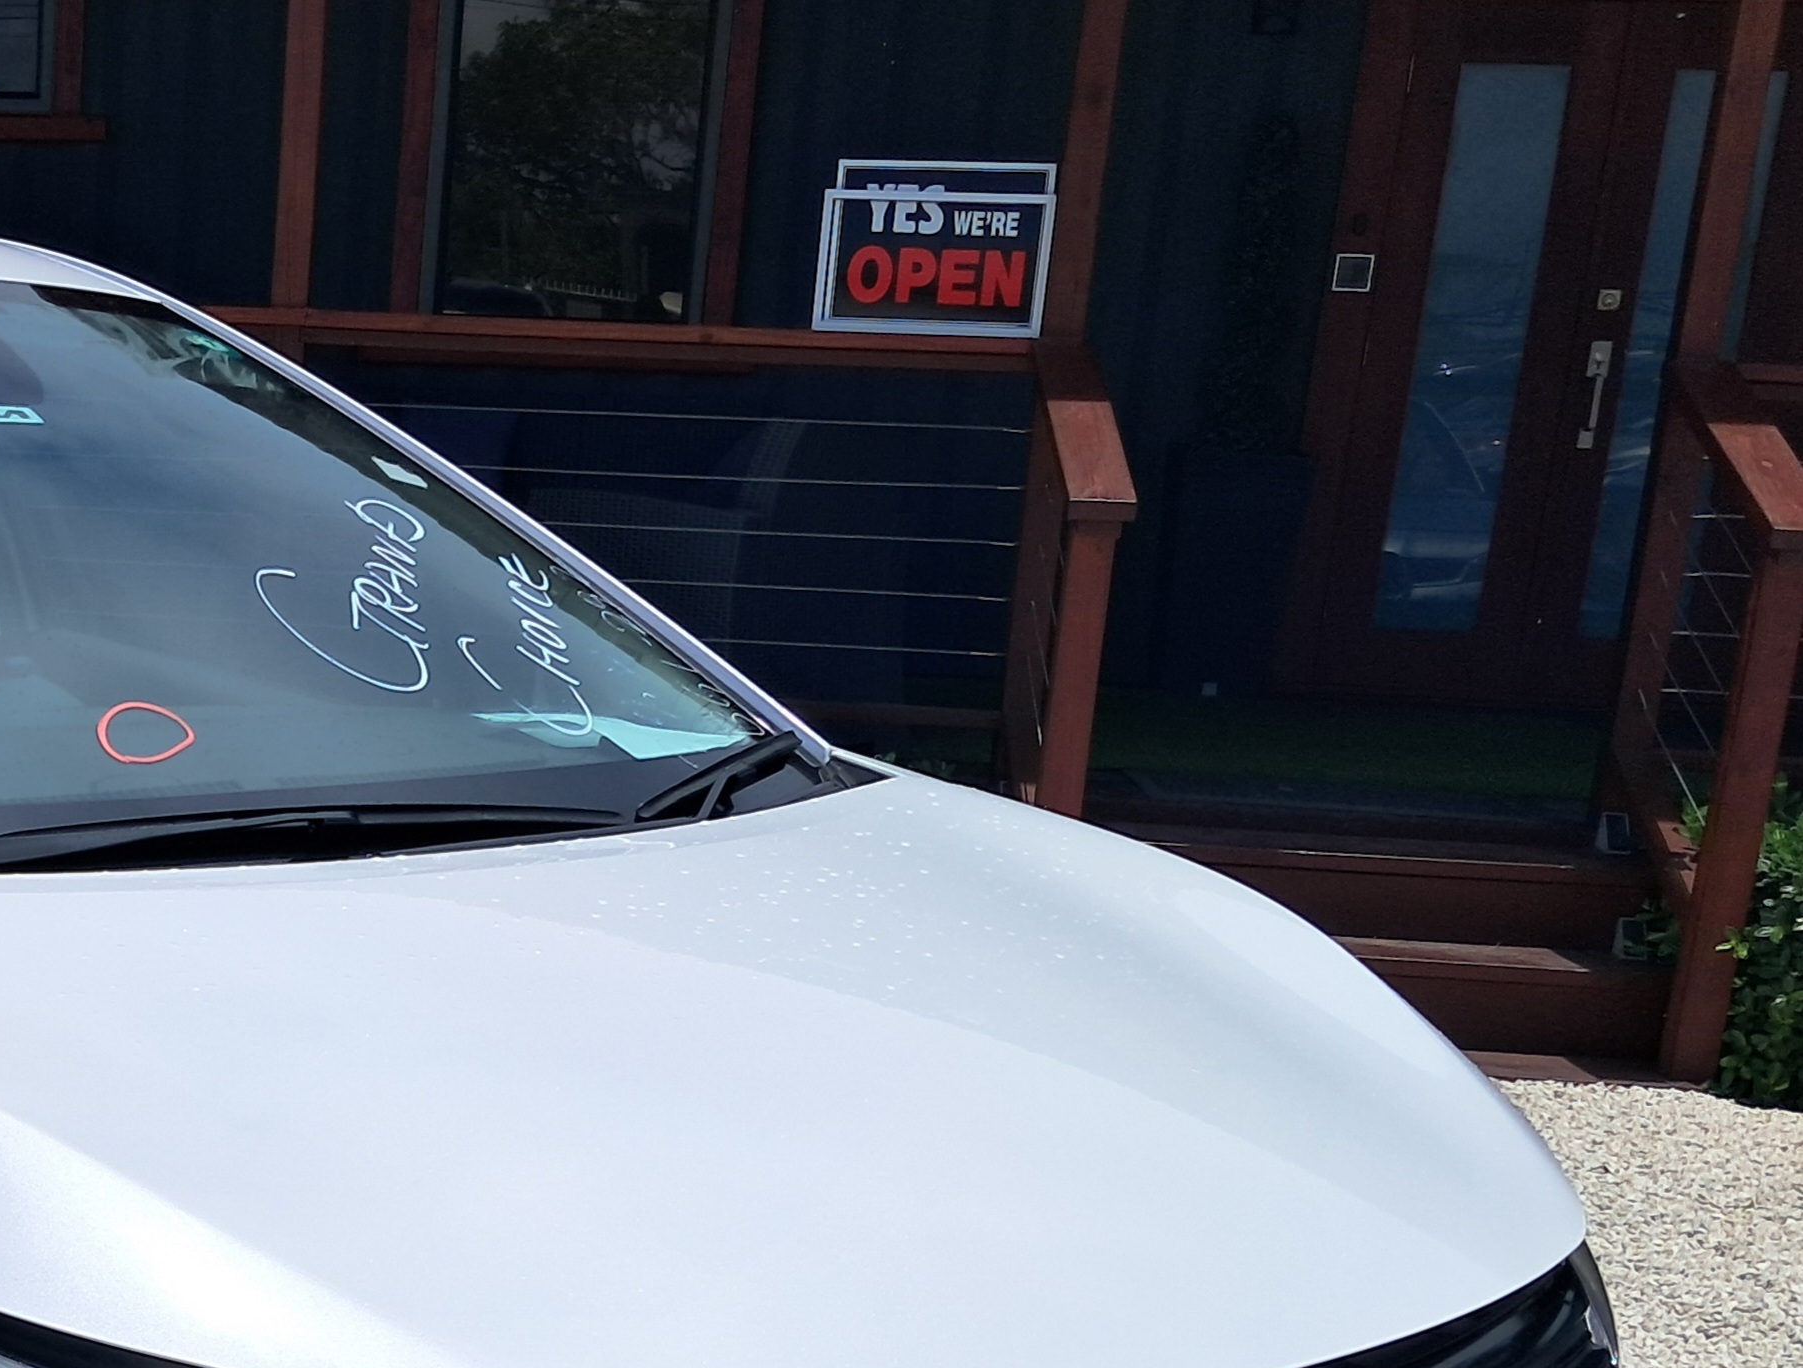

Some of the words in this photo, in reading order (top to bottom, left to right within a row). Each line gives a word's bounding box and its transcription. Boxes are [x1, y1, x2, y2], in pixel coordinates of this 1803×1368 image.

[866, 183, 946, 235] YES
[953, 210, 1021, 238] WE'RE
[847, 245, 1027, 307] OPEN
[254, 498, 430, 693] GRAND
